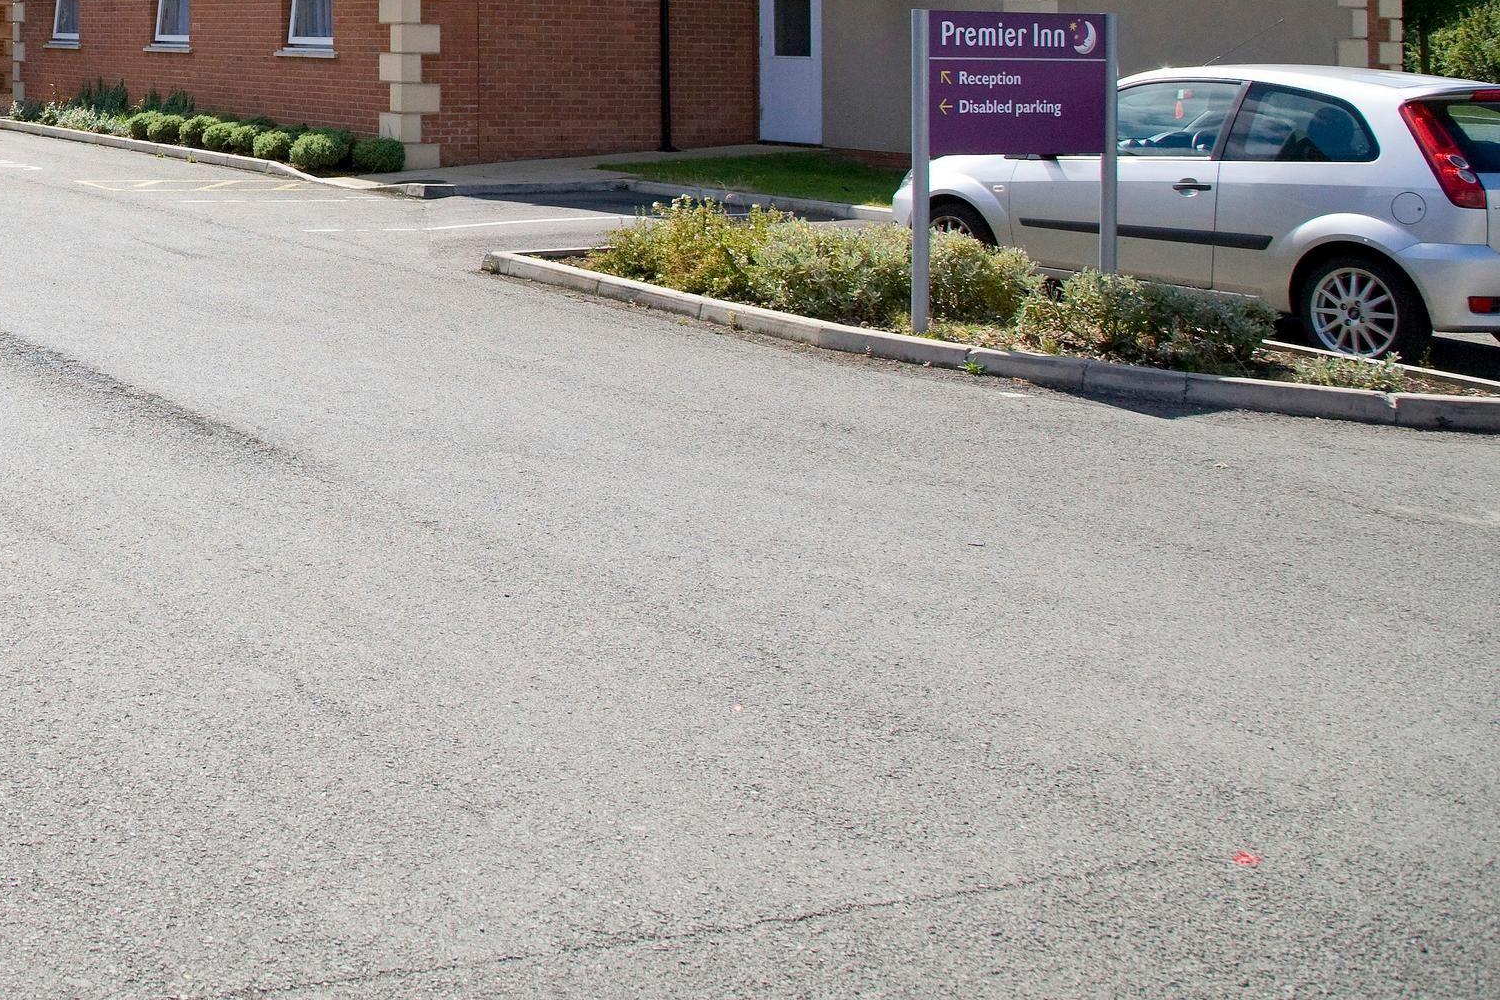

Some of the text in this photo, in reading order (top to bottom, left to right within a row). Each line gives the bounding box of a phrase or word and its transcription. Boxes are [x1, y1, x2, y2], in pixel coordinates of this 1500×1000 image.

[941, 21, 1066, 48] Premier Inn
[958, 71, 1022, 89] Reception
[958, 99, 1062, 117] Disabled parking
